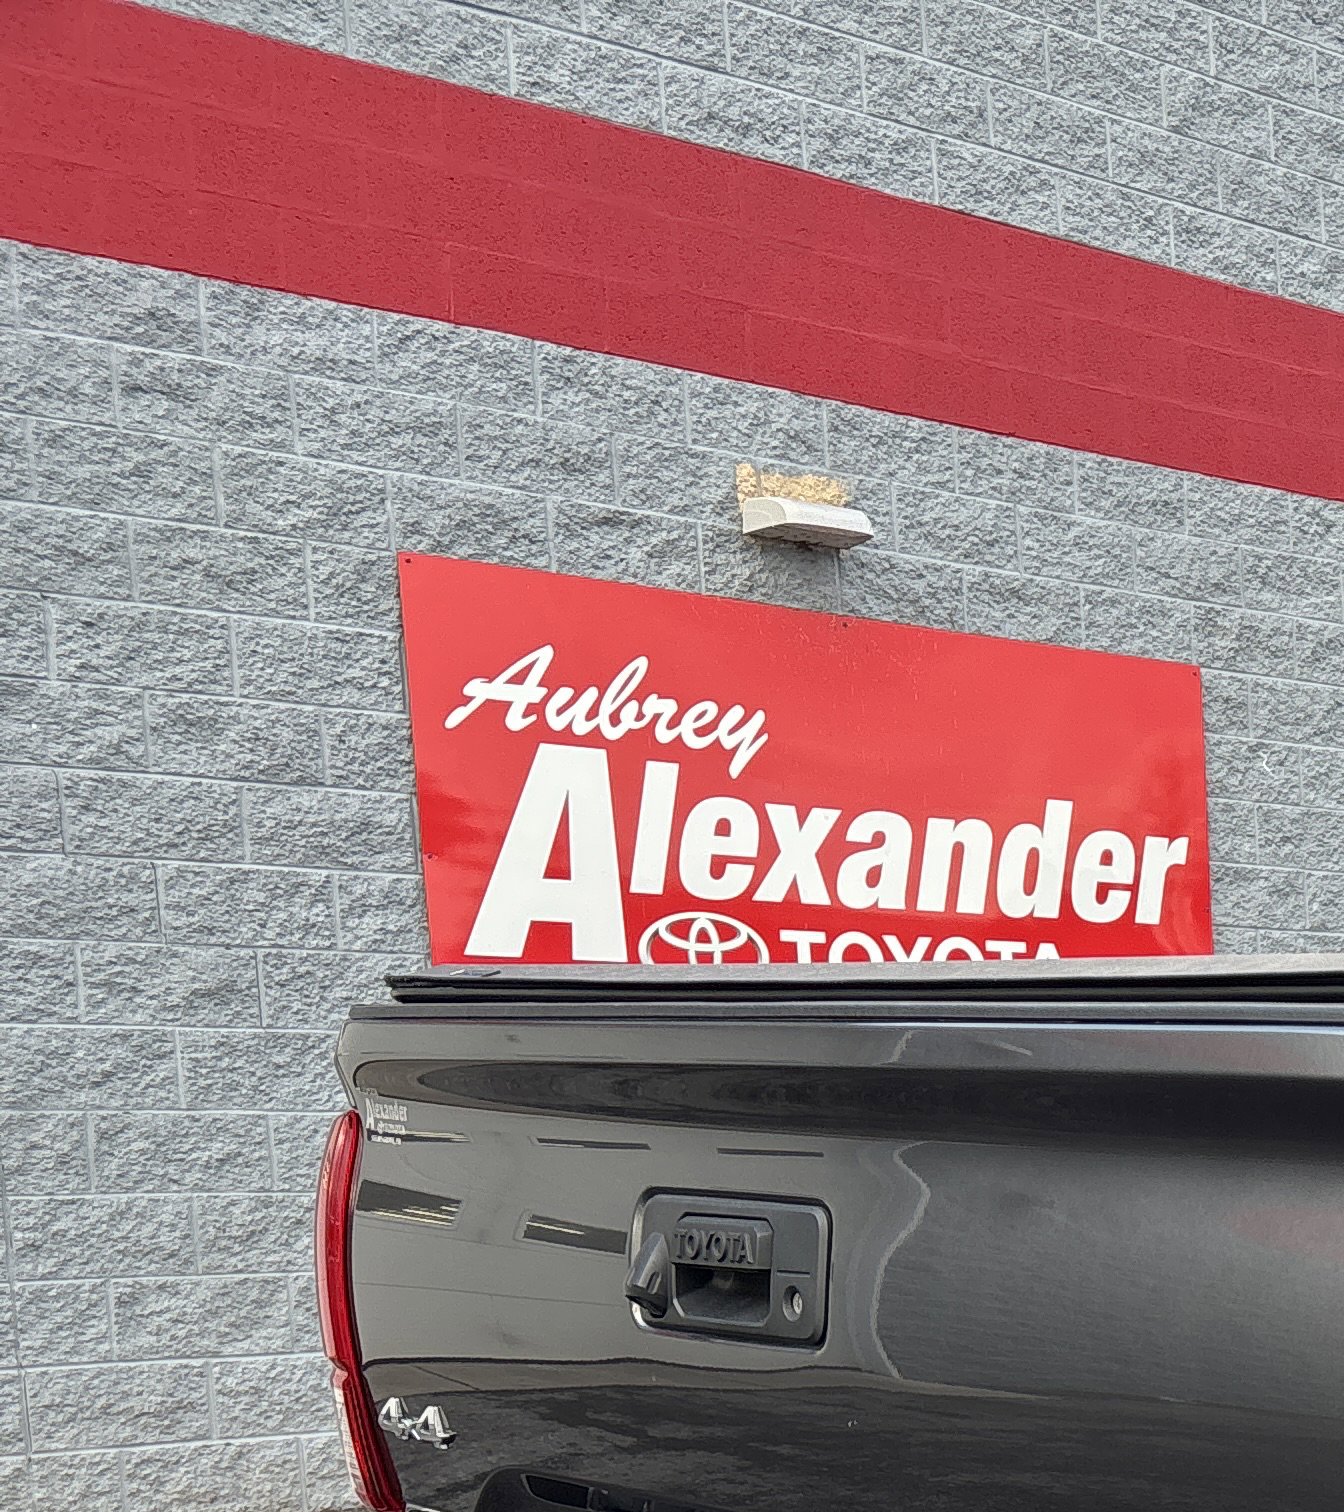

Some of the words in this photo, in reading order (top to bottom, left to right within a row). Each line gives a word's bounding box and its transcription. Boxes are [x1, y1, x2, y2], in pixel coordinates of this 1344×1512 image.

[445, 644, 770, 779] Aubrey
[464, 743, 1189, 963] Alexander
[674, 1228, 754, 1264] TOYOTA
